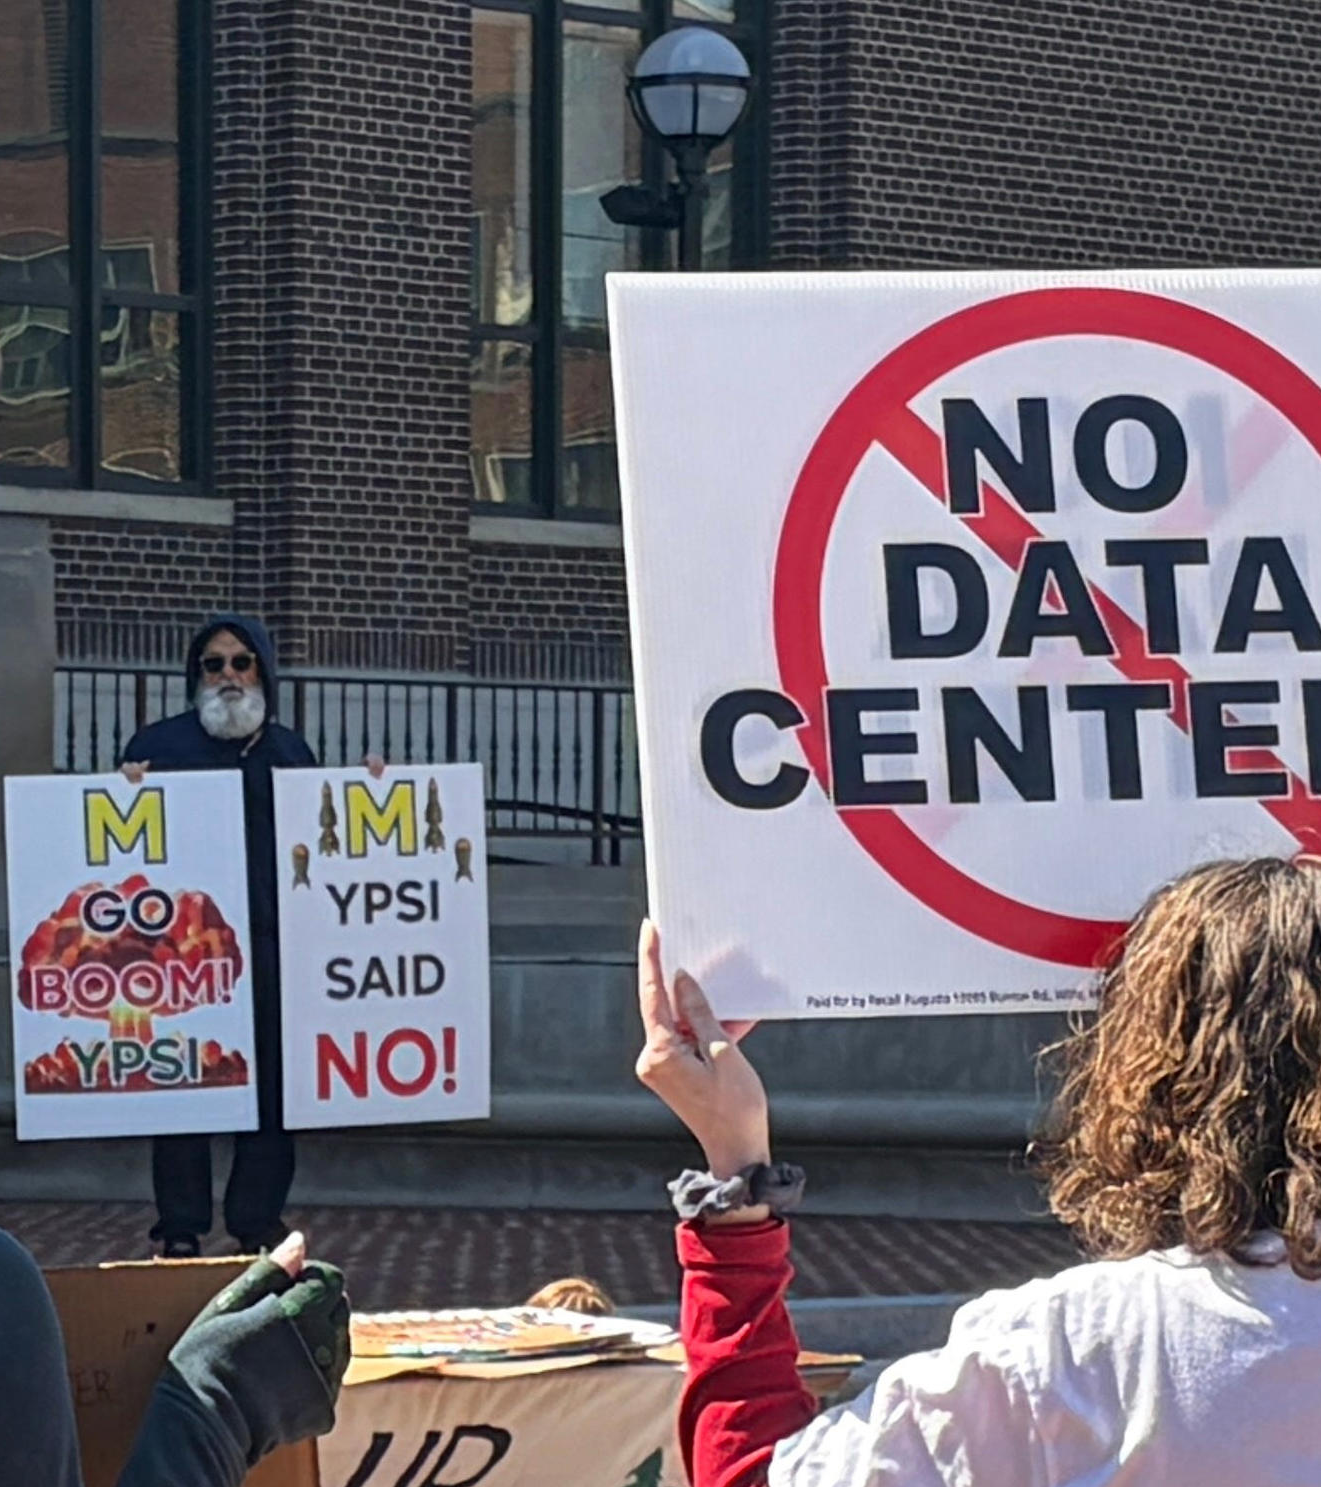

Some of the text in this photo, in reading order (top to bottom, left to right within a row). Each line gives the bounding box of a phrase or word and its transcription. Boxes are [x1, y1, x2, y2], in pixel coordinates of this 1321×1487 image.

[941, 394, 1188, 515] NO
[82, 787, 167, 866] M
[343, 779, 419, 859] M
[82, 888, 175, 934] GO
[325, 880, 440, 925] YPSI
[32, 957, 235, 1011] BOOM!
[325, 954, 446, 1001] SAID
[71, 1037, 203, 1086] YPSI
[316, 1026, 458, 1101] NO!
